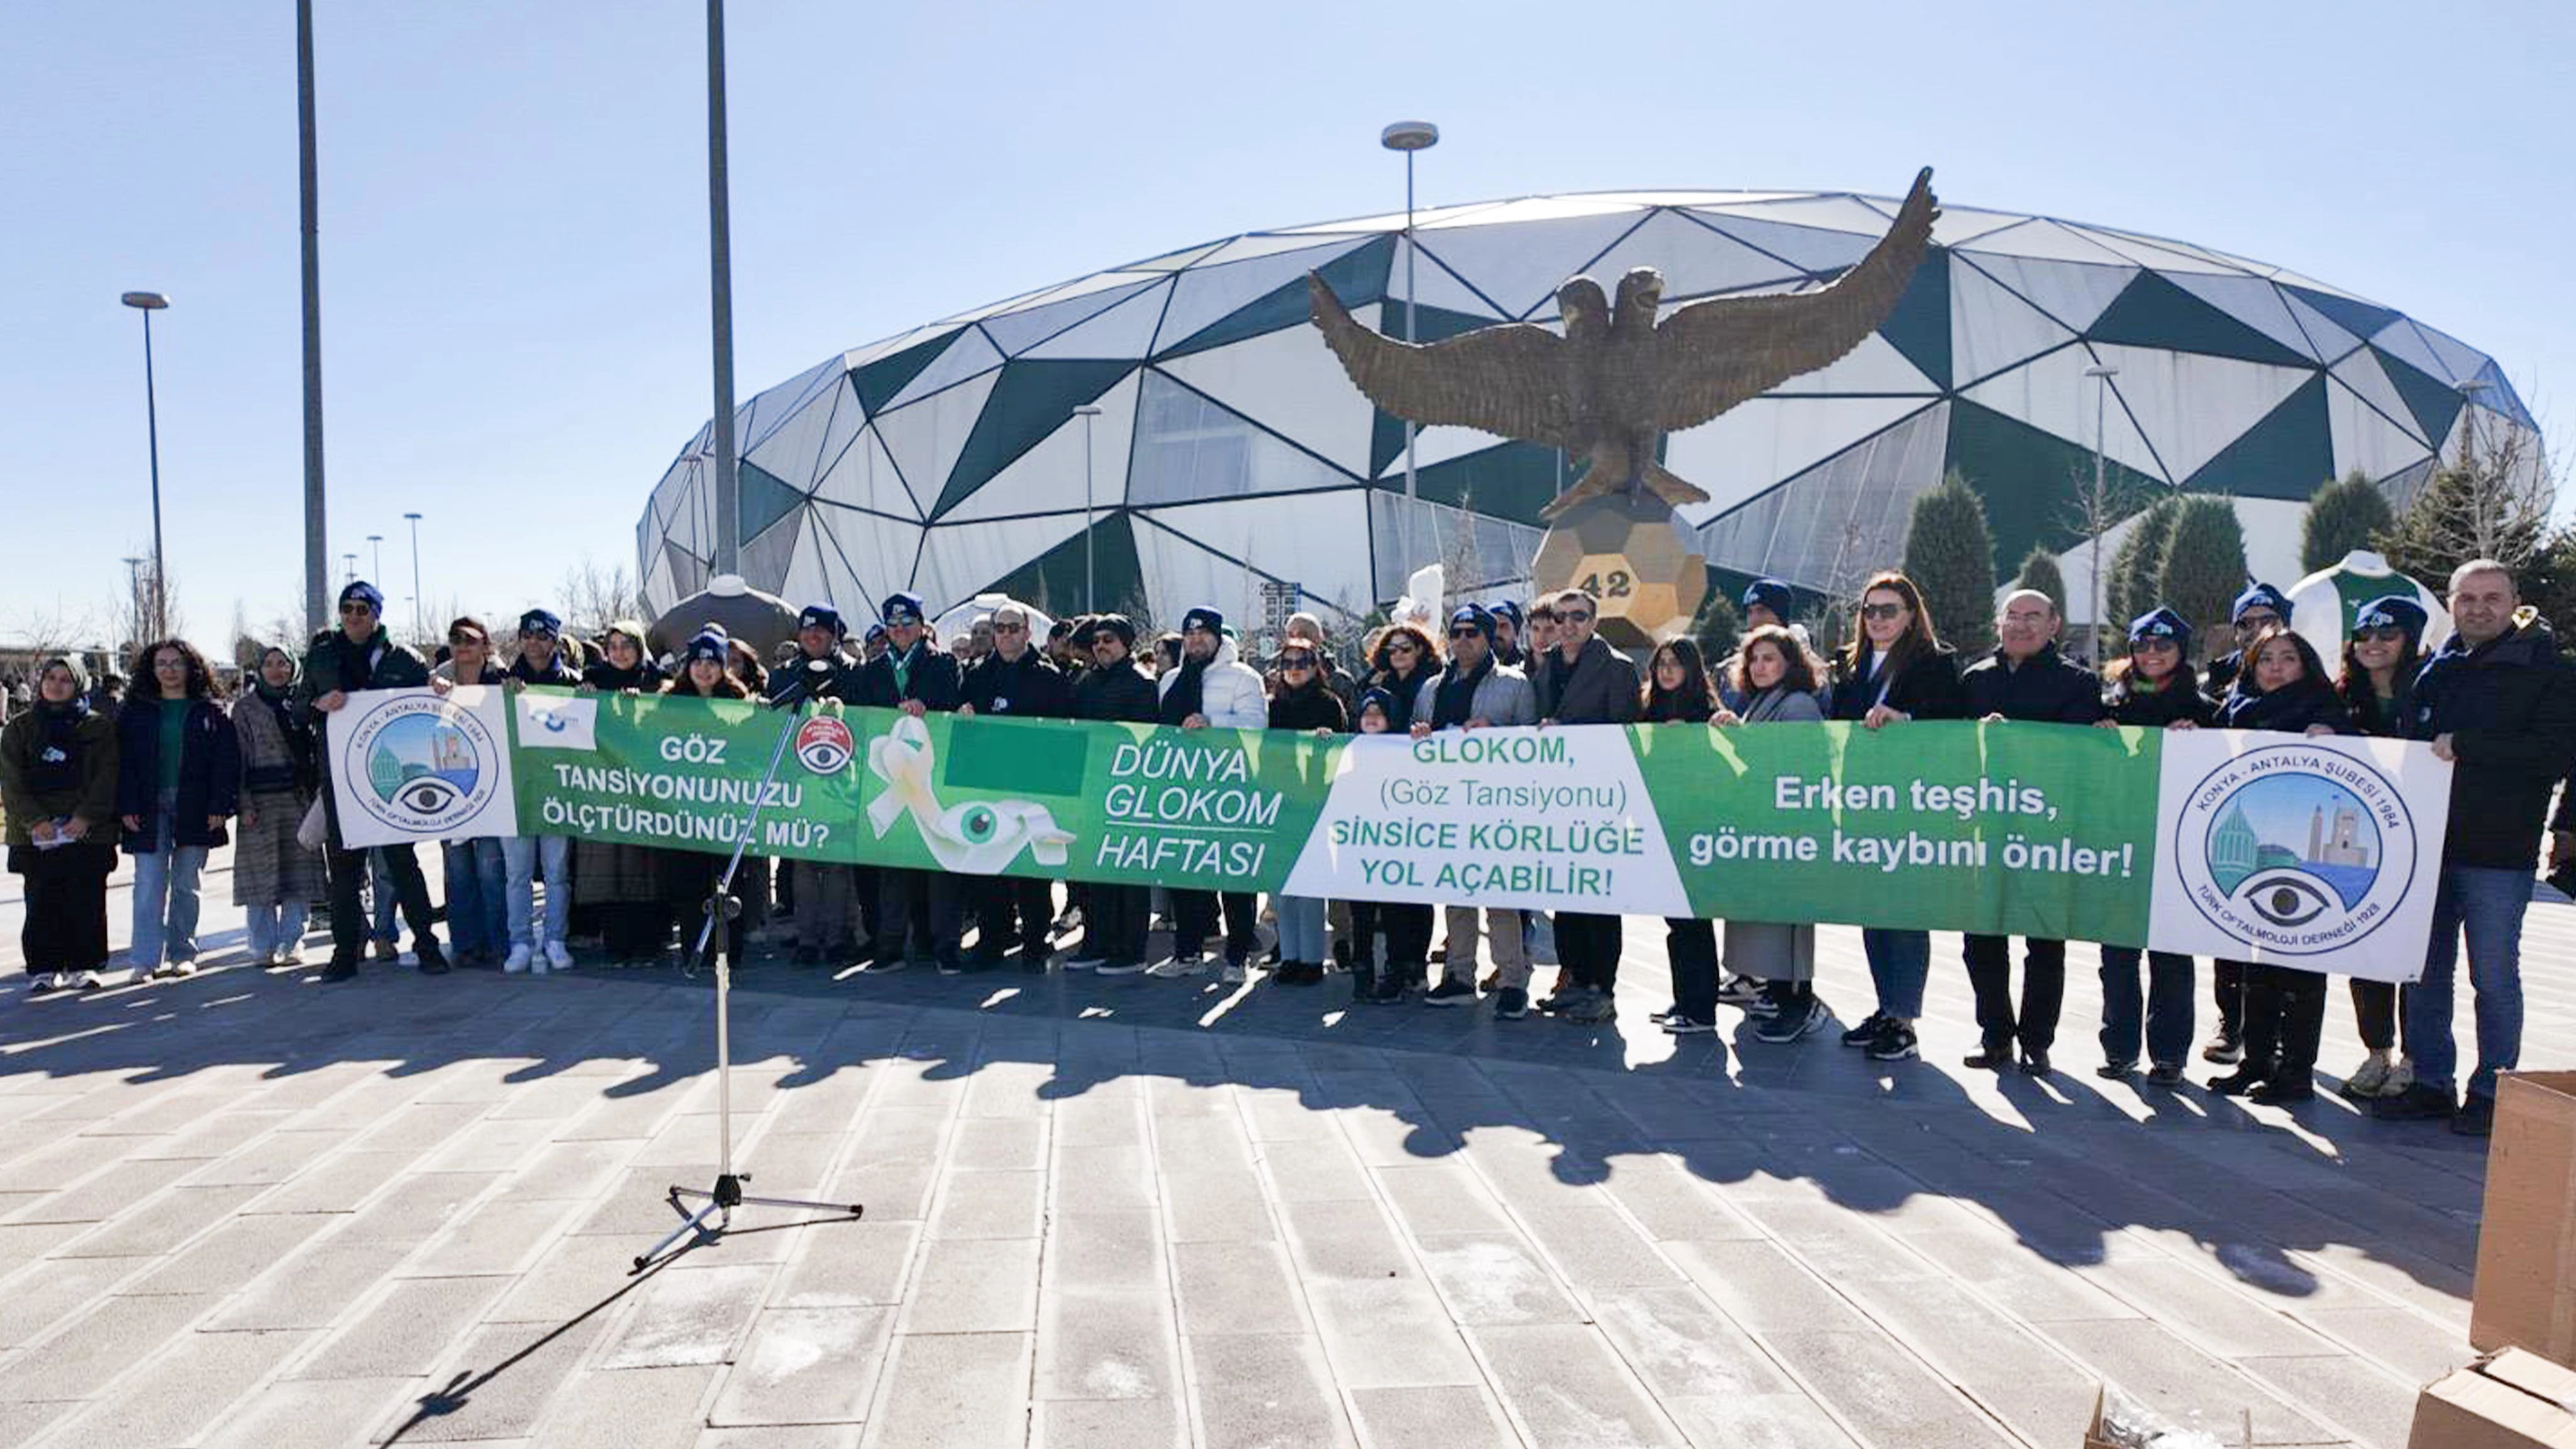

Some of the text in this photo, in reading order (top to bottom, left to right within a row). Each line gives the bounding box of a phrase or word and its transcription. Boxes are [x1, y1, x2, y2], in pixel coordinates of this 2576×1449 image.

[1579, 570, 1630, 598] 42
[660, 733, 726, 764] GÖZ
[1111, 740, 1248, 784] DÜNYA
[1413, 736, 1575, 766] GLOKOM,
[553, 764, 802, 808] TANSİYONUNUZU
[1105, 784, 1283, 825] GLOKOM
[1380, 778, 1627, 814] (Göz Tansiyonu)
[1775, 776, 2060, 821] Erken teşhis,
[2197, 772, 2240, 812] KONYA
[2250, 756, 2320, 772] ANTALYA
[2375, 795, 2400, 829] 1984
[765, 819, 830, 849] MÜ?
[1331, 815, 1644, 856] SİNSİCE KÖRLÜĞE
[1689, 828, 2135, 878] görme kaybını önler!
[1096, 833, 1265, 877] HAFTASI
[1358, 859, 1613, 897] YOL AÇABİLİR!
